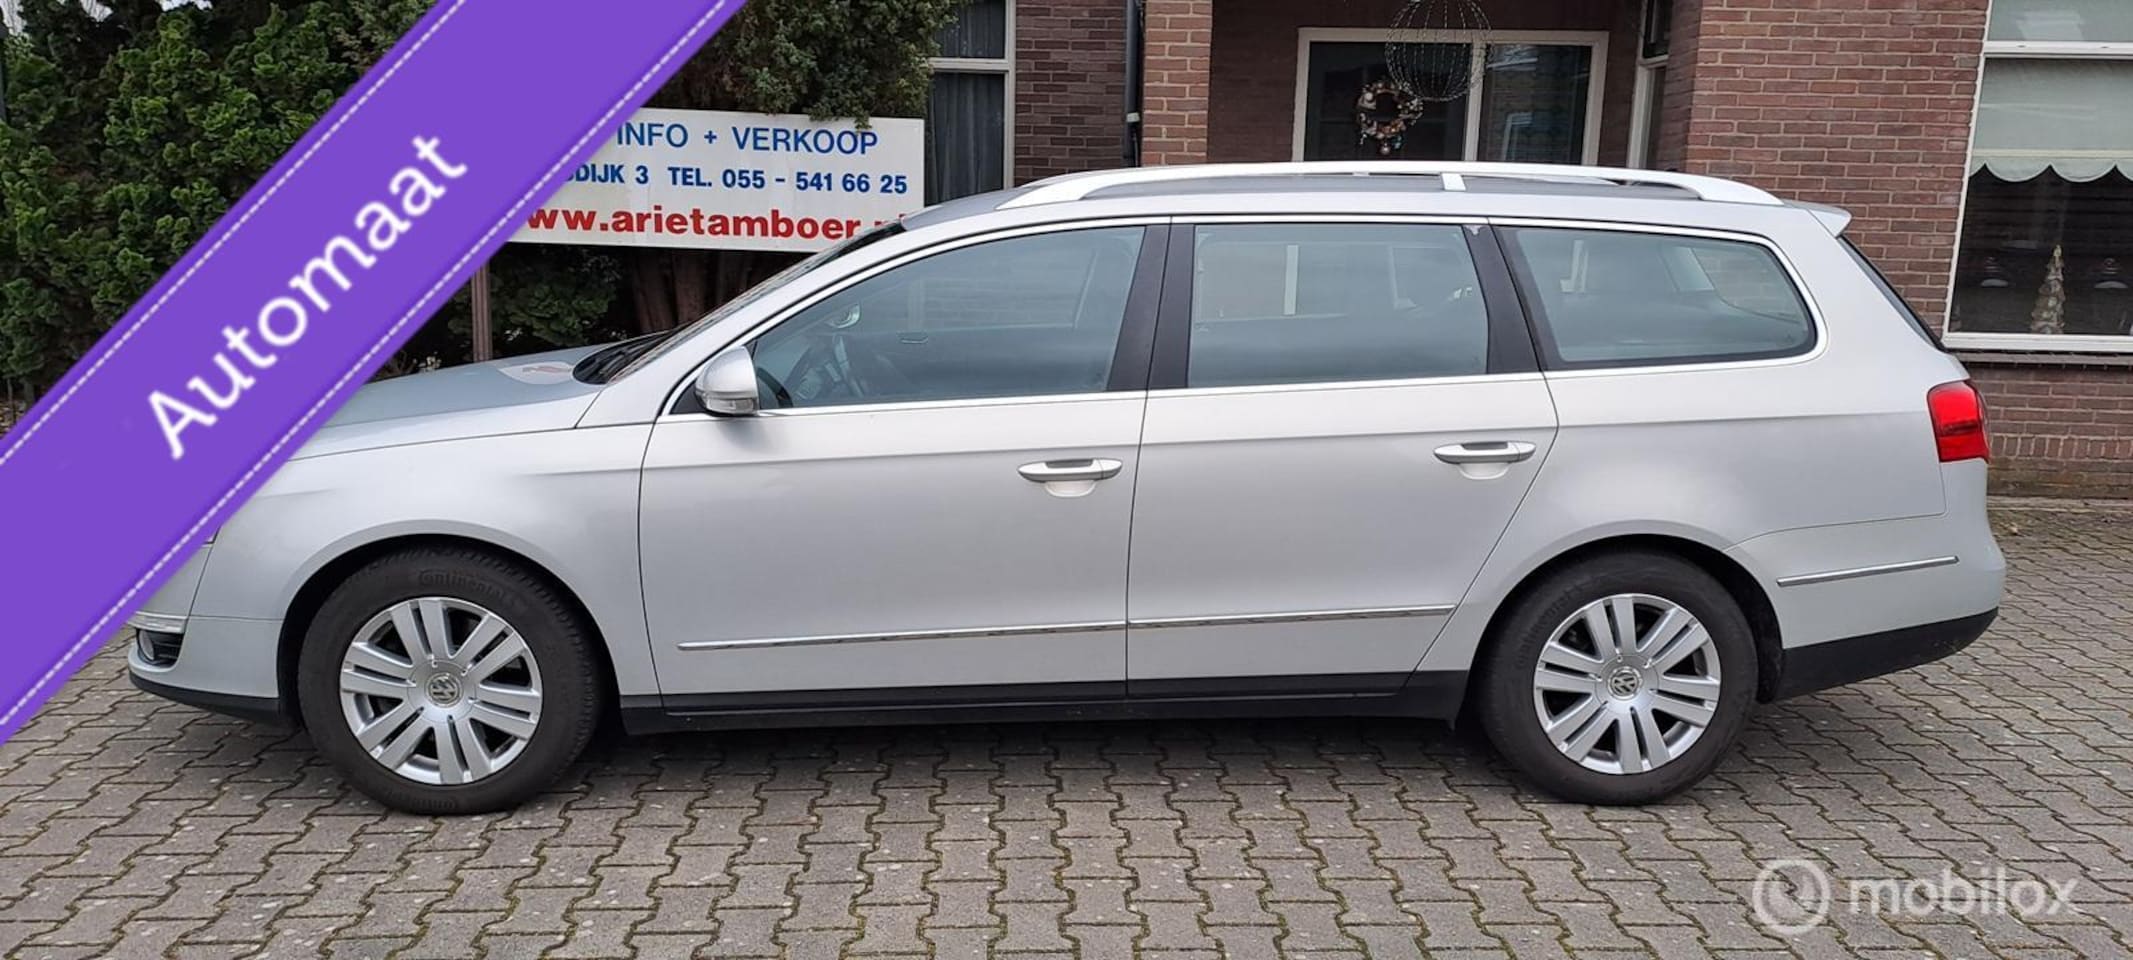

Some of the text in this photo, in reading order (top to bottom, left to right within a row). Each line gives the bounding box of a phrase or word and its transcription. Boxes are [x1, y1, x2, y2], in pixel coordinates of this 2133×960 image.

[617, 122, 878, 155] INFO + VERKOOP
[567, 163, 625, 184] DIJK
[635, 164, 649, 185] 3
[667, 166, 713, 188] TEL.
[722, 168, 766, 190] 055
[795, 171, 833, 193] 541
[841, 172, 871, 193] 66
[880, 174, 908, 195] 25
